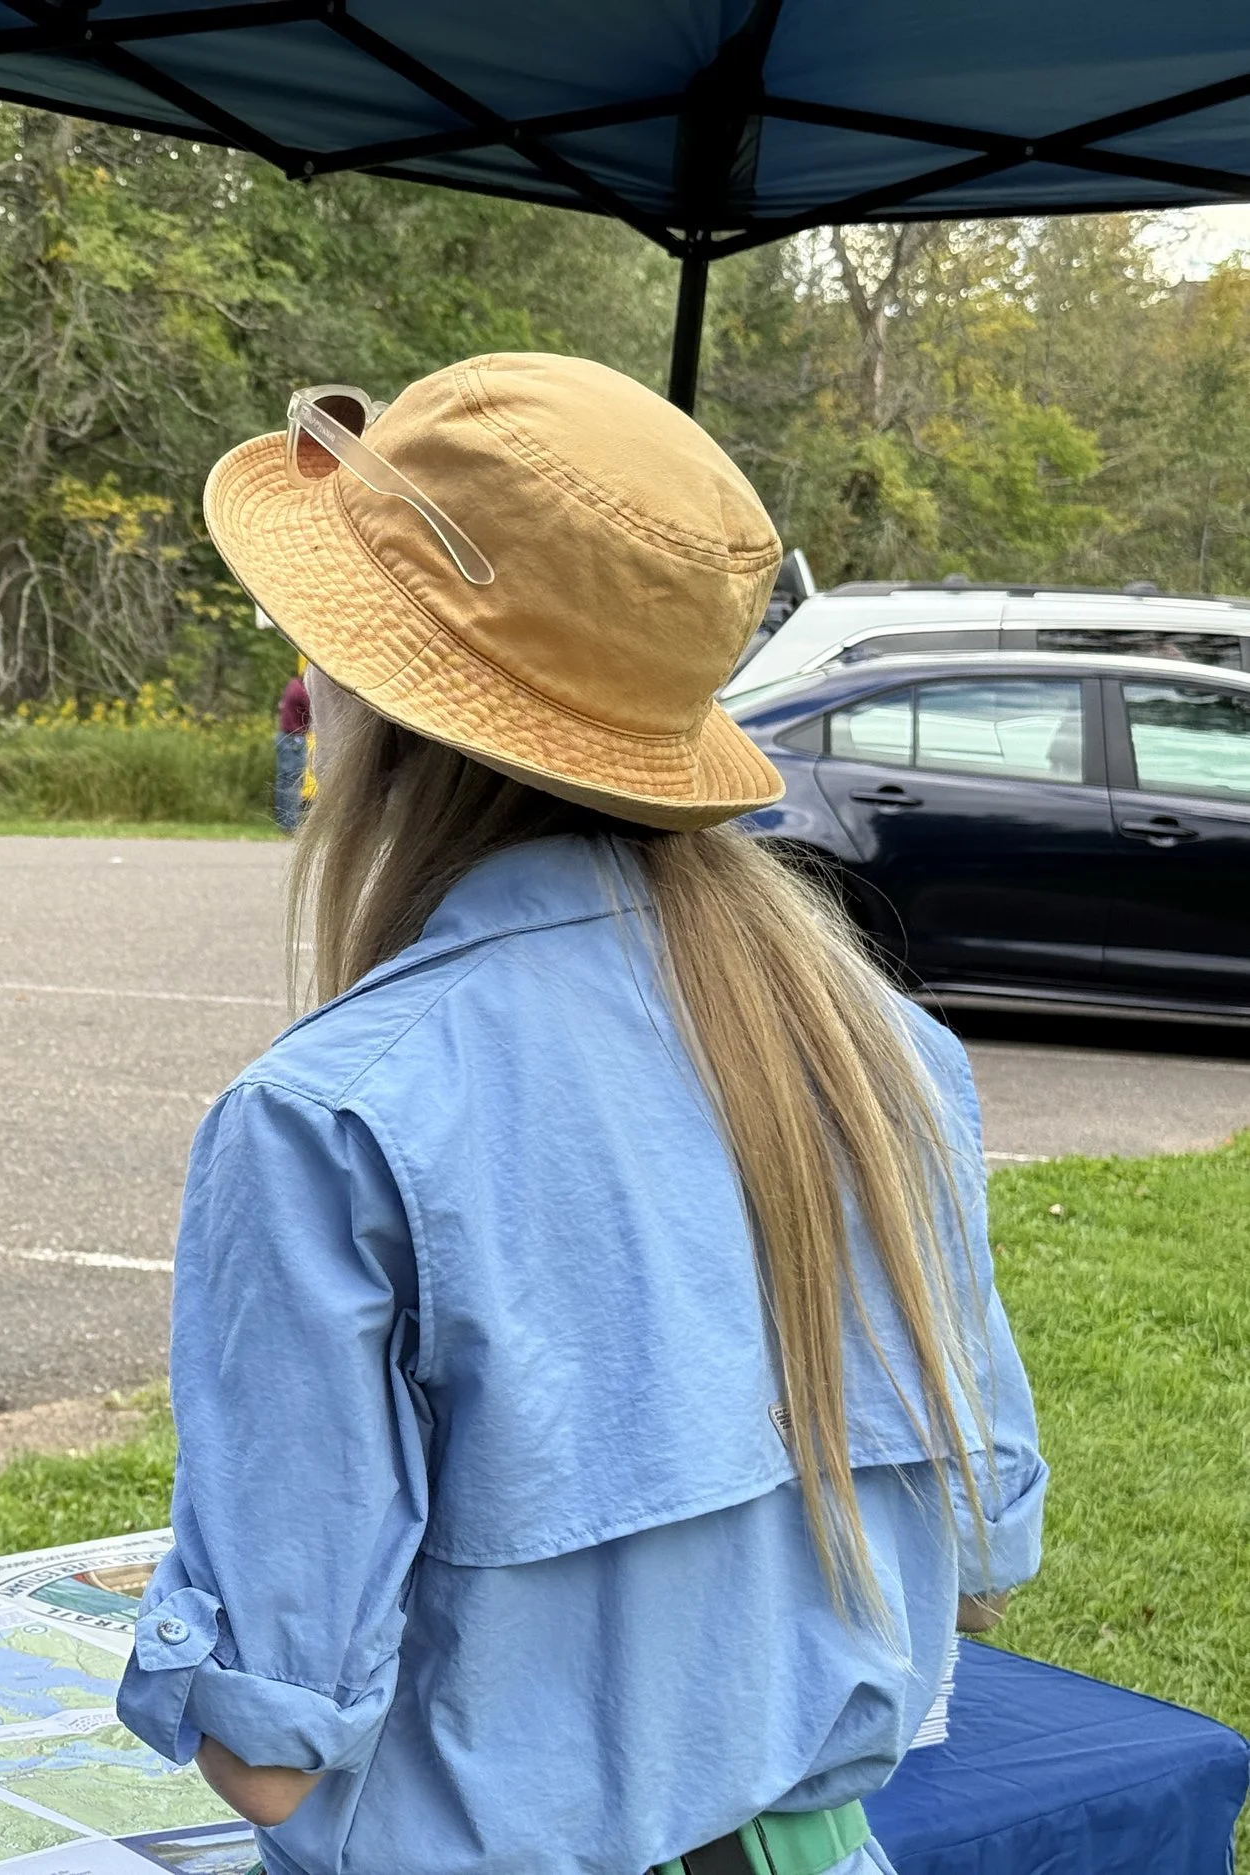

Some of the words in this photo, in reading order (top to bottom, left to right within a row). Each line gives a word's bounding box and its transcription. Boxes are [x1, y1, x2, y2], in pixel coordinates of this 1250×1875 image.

[60, 1557, 113, 1578] RIVER
[113, 1552, 165, 1564] OUIS
[47, 1607, 129, 1632] TRAIL
